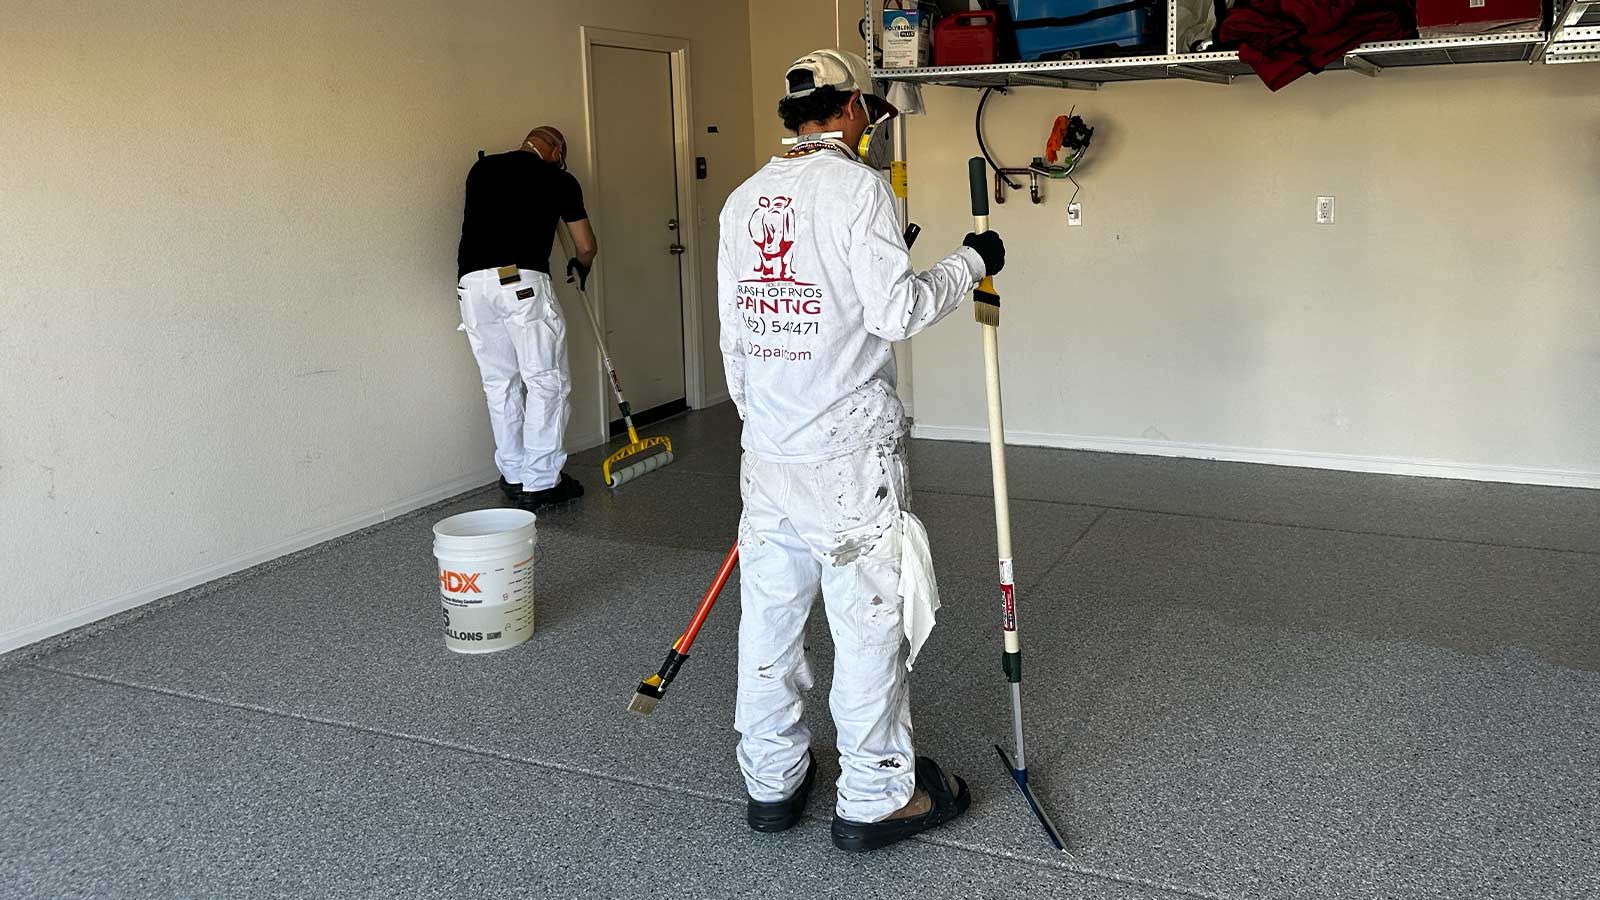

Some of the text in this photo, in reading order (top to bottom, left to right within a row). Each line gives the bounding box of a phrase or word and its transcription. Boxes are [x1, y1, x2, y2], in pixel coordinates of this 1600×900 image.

[767, 287, 787, 297] OF
[439, 569, 482, 593] HDX
[442, 607, 451, 627] 5
[445, 628, 484, 641] ALLONS
